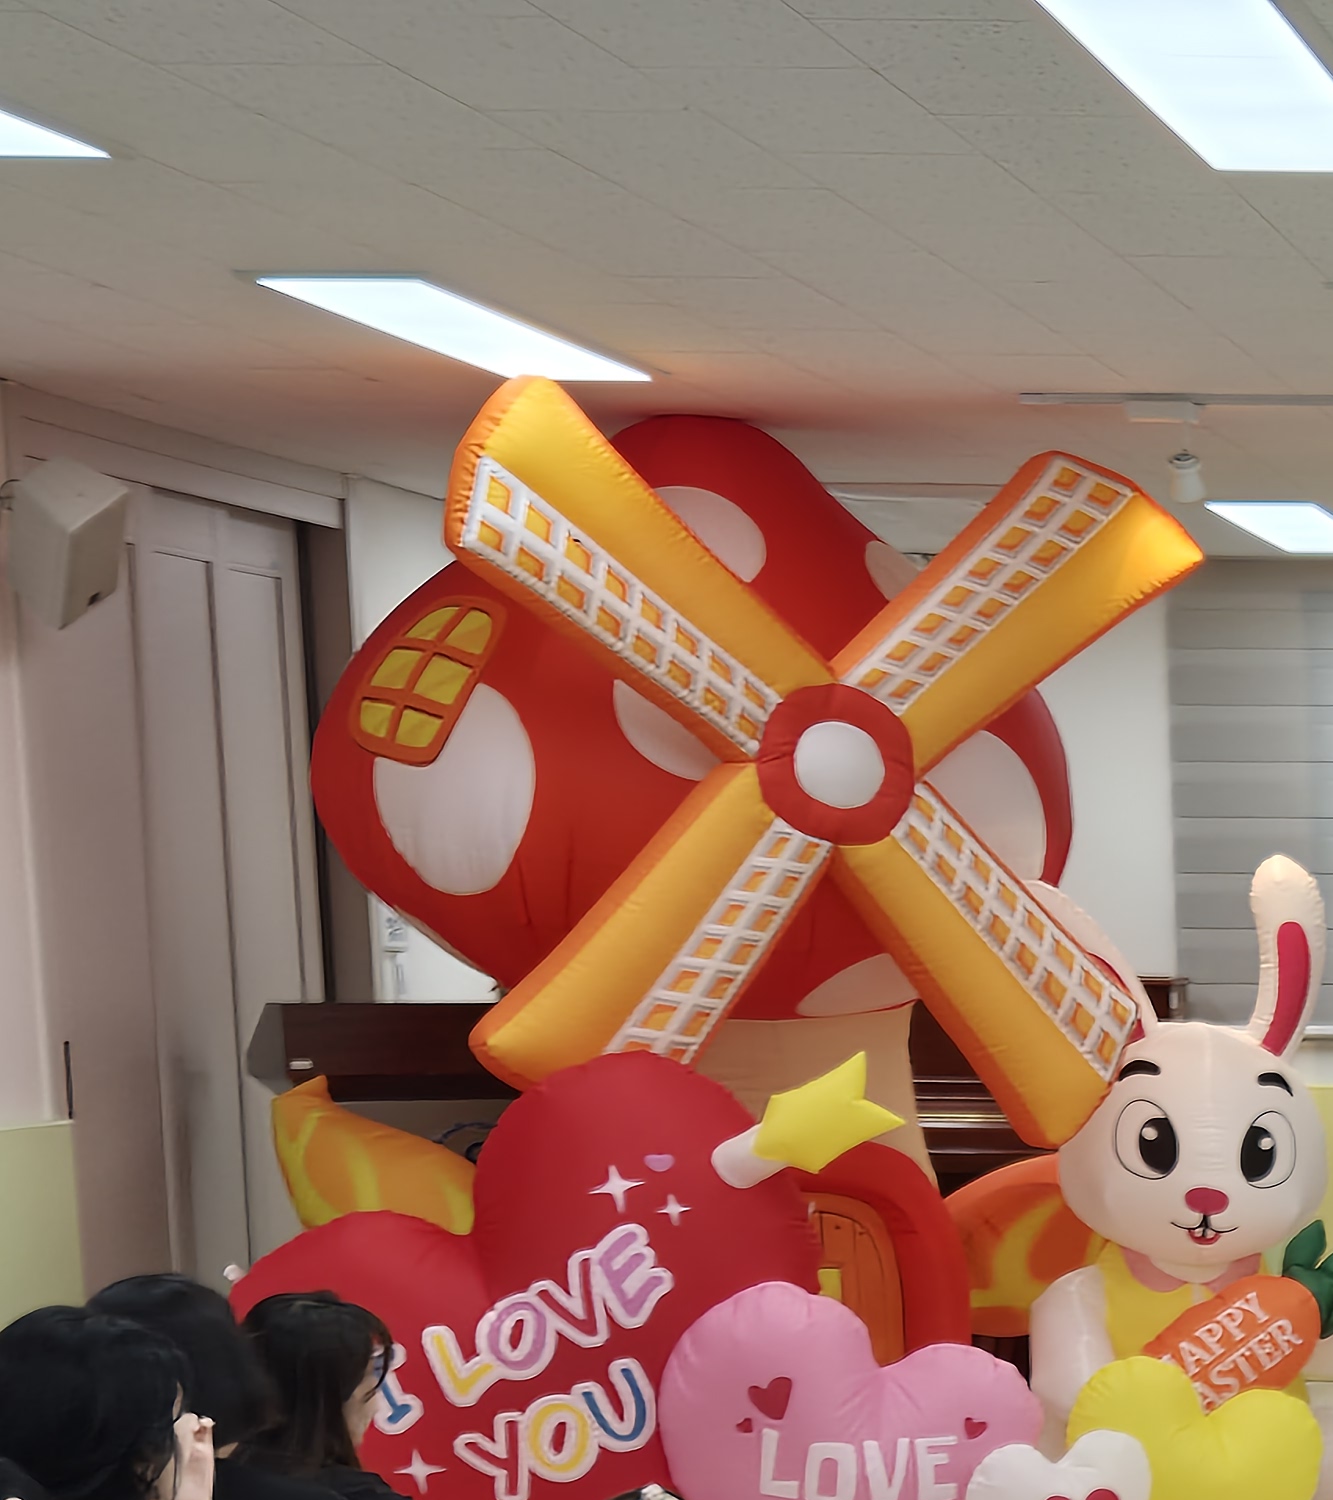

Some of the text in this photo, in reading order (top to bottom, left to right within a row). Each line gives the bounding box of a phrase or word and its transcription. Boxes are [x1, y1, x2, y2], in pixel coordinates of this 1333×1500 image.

[421, 1223, 675, 1407] LOVE
[1160, 1291, 1270, 1378] APPY
[1192, 1318, 1304, 1416] ASTER
